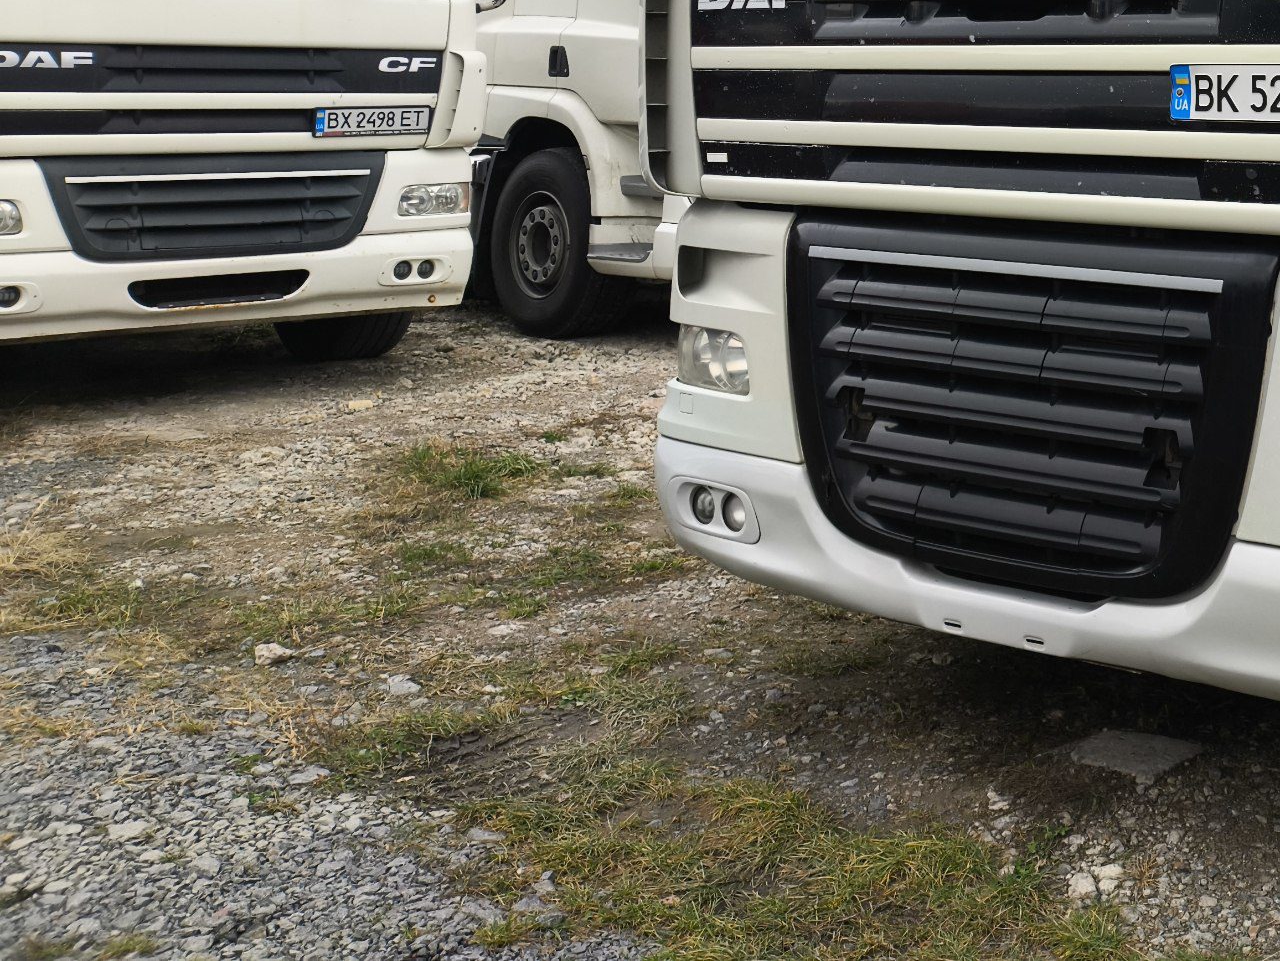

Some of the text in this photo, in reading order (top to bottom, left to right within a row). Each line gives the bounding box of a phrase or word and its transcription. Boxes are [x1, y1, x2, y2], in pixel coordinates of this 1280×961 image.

[0, 50, 93, 69] DAF
[378, 56, 437, 73] CF
[1194, 74, 1239, 113] BK
[1174, 99, 1189, 111] UA
[327, 110, 424, 129] BX 2498 ET
